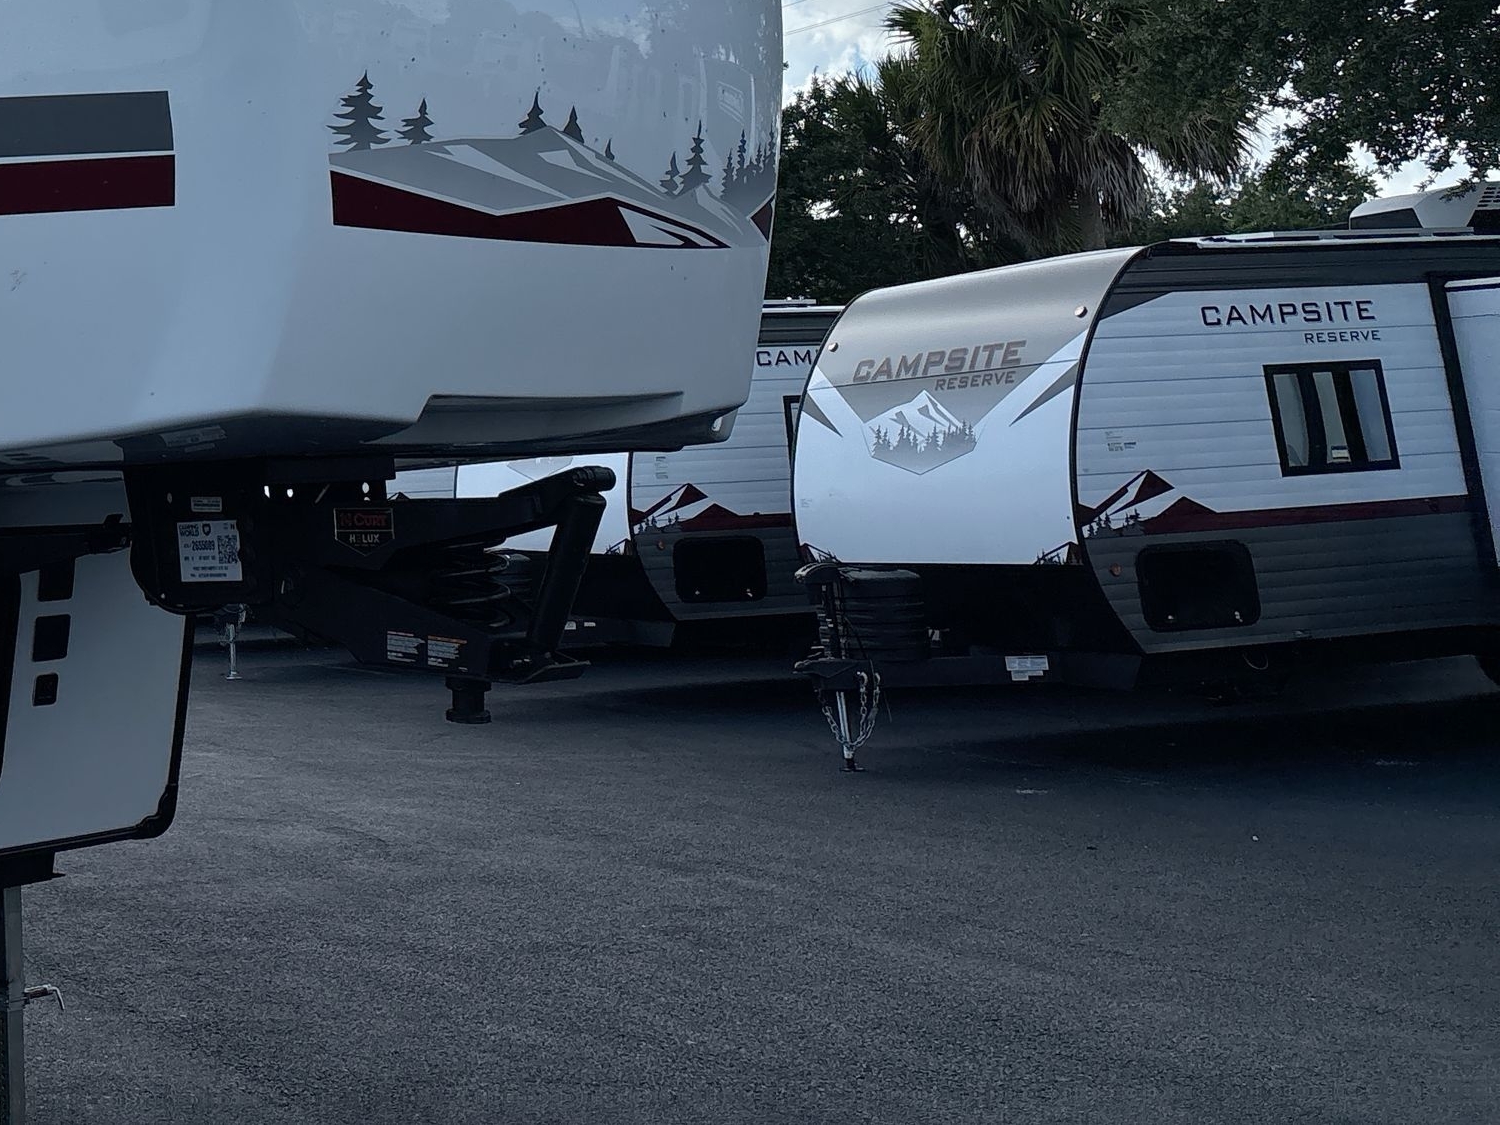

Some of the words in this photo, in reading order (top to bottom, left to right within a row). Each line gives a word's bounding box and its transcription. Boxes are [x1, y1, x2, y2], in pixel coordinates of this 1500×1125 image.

[1201, 300, 1376, 326] CAMPSITE
[1304, 330, 1381, 344] RESERVE
[756, 349, 818, 367] CAM
[853, 340, 1027, 383] CAMPSITE
[935, 371, 1017, 391] RESERVE
